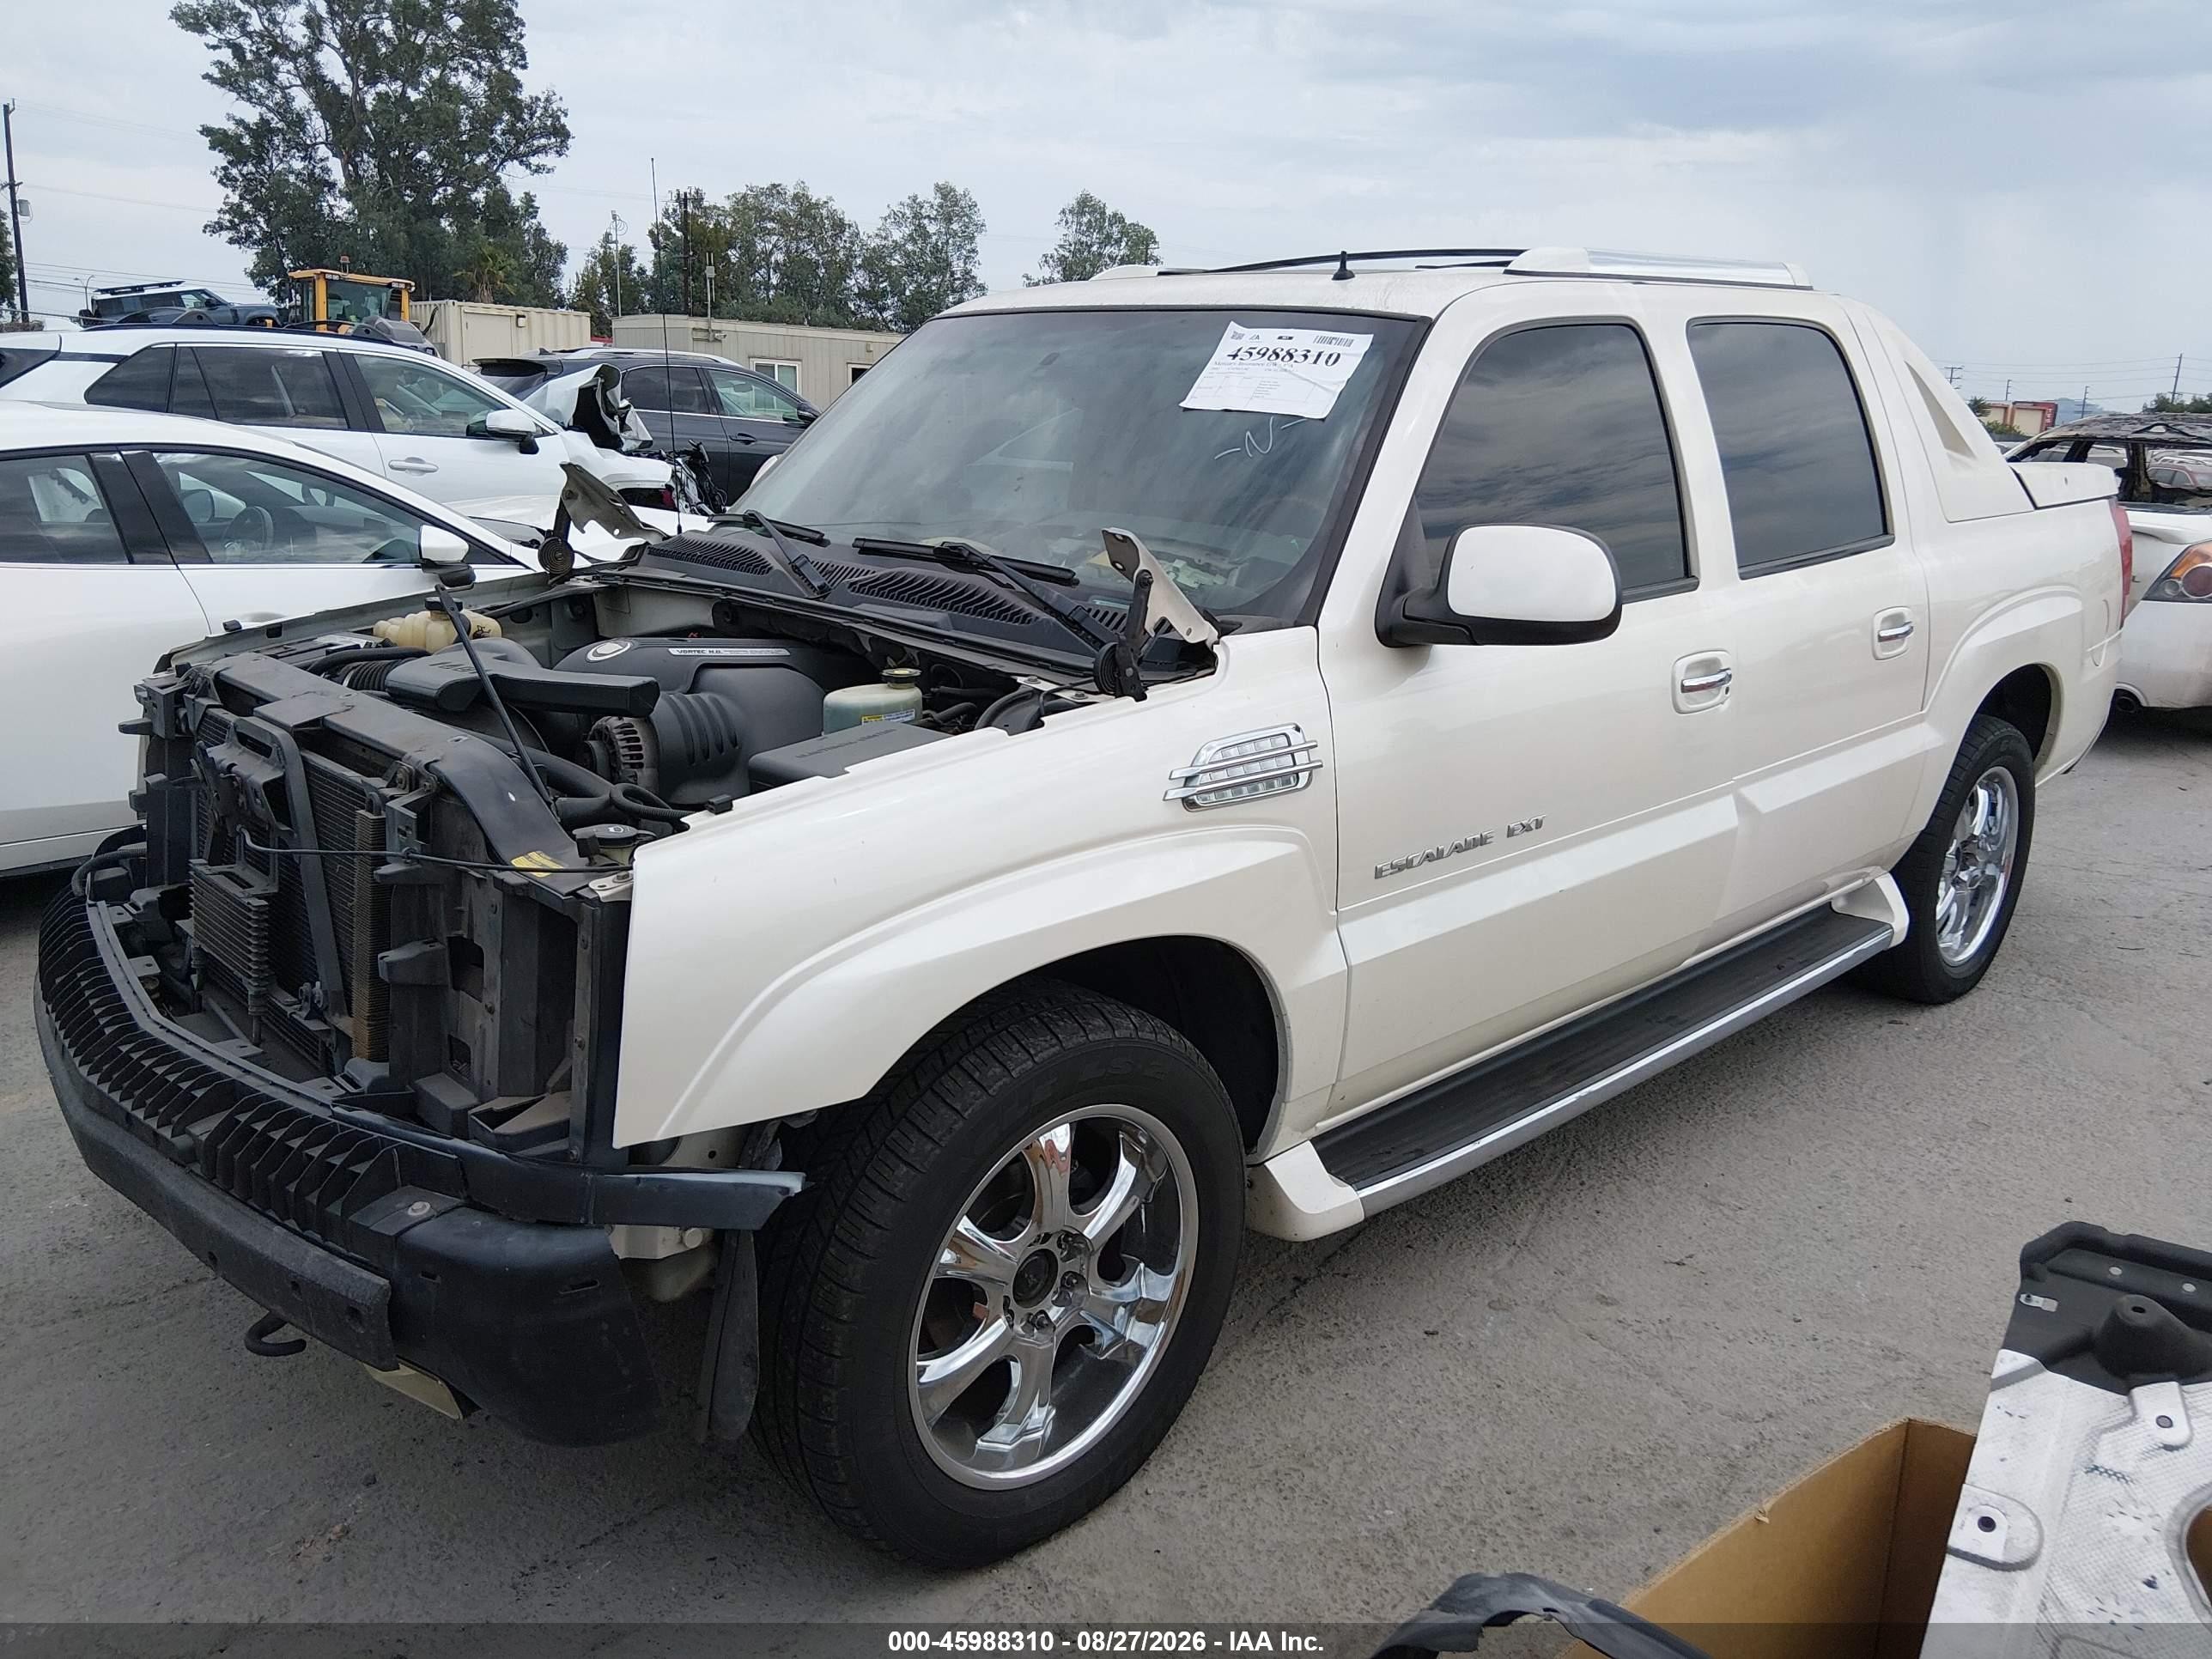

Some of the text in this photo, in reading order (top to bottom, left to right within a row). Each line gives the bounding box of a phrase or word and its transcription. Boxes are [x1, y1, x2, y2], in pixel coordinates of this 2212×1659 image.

[1226, 346, 1341, 368] 45988310
[1374, 815, 1547, 879] ESCALADE EXT
